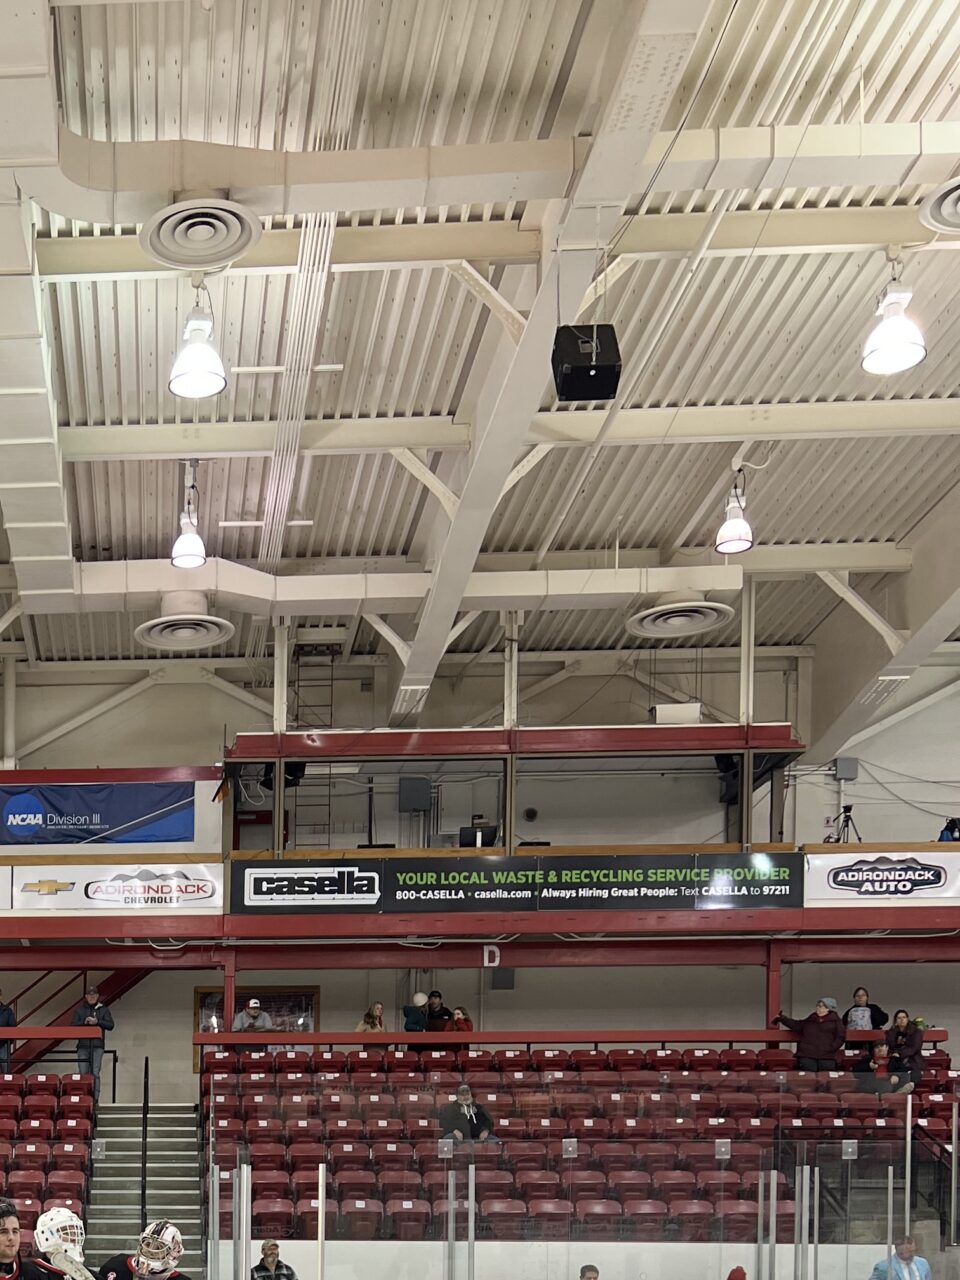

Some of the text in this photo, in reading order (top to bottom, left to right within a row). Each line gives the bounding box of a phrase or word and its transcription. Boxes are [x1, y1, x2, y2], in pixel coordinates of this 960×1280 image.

[7, 814, 43, 825] NCAA
[47, 813, 100, 825] Division III
[396, 867, 790, 885] YOUR LOCAL WASTE & RECYCLING SERVICE PROVIDER
[837, 870, 935, 881] ADIRONDACK
[253, 871, 375, 895] casella
[860, 881, 912, 892] AUTO
[92, 884, 208, 895] ADIRONDACK
[395, 885, 790, 900] 800-CASELLA casella.com Always Hiring Great People: Text CASELLA to 97211
[124, 896, 180, 904] CHEVROLET
[482, 945, 501, 967] D
